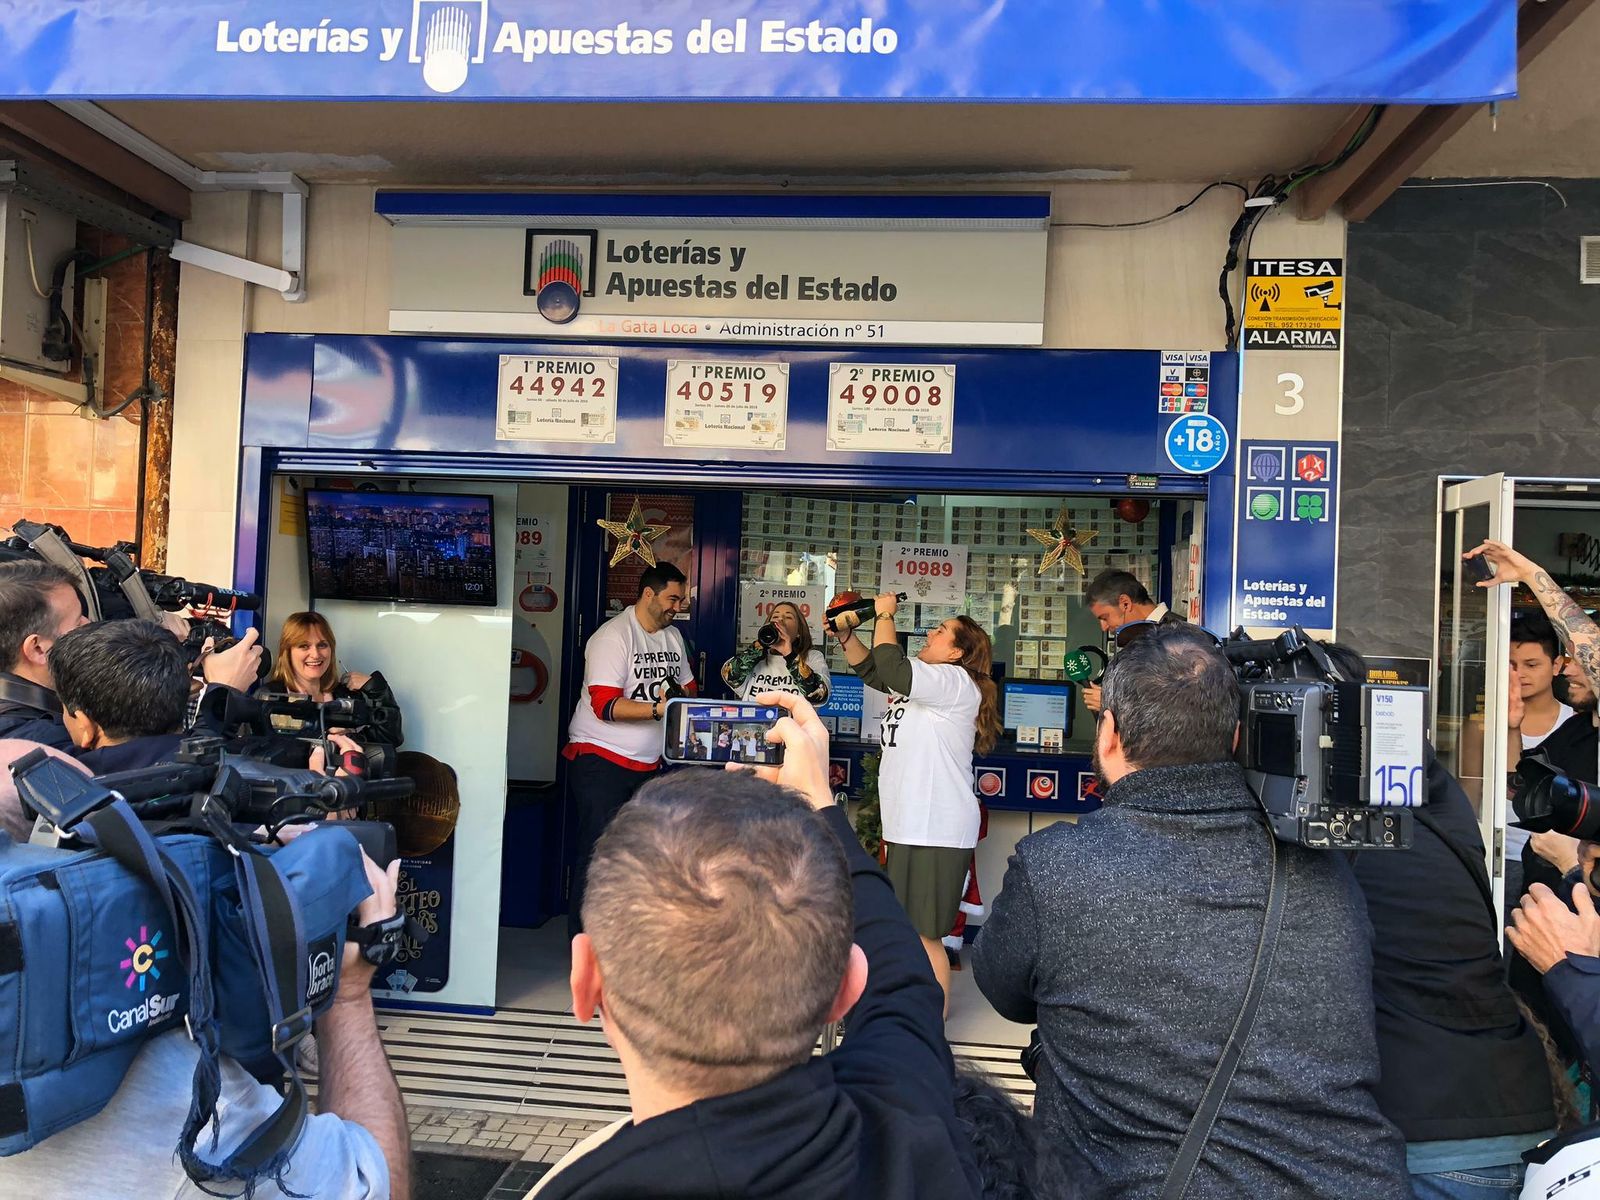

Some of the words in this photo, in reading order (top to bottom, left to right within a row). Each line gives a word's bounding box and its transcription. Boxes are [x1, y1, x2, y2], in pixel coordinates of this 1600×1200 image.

[216, 18, 369, 53] Loterías
[379, 27, 404, 61] y
[492, 21, 673, 63] Apuestas
[686, 18, 747, 54] del
[760, 17, 898, 55] Estado
[606, 239, 721, 265] Loterías
[729, 247, 747, 272] y
[1253, 261, 1337, 276] ITESA
[605, 271, 737, 302] Apuestas
[745, 274, 789, 300] del
[797, 275, 898, 302] Estado
[600, 320, 616, 333] La
[621, 320, 658, 335] Gata
[663, 320, 698, 335] Loca
[719, 322, 839, 338] Administración
[845, 324, 862, 338] nº
[867, 324, 885, 338] 51
[1248, 330, 1337, 345] ALARMA
[536, 361, 596, 375] PREMIO
[704, 366, 766, 380] PREMIO
[871, 369, 935, 383] PREMIO
[509, 375, 606, 398] 44942
[676, 381, 777, 404] 40519
[1275, 372, 1304, 415] 3
[839, 384, 941, 406] 49008
[1173, 428, 1214, 452] +18
[516, 518, 538, 526] EMIO
[515, 531, 542, 545] 89
[914, 548, 949, 557] PREMIO
[896, 560, 953, 576] 10989
[464, 583, 483, 591] 12:01
[772, 590, 806, 598] PREMIO
[1243, 580, 1296, 592] Loterías
[1299, 583, 1307, 594] y
[1244, 594, 1303, 607] Apuestas
[1306, 596, 1326, 607] del
[755, 602, 811, 617] 109
[1243, 609, 1287, 621] Estado
[756, 674, 798, 686] PREMI
[1376, 695, 1393, 703] V150
